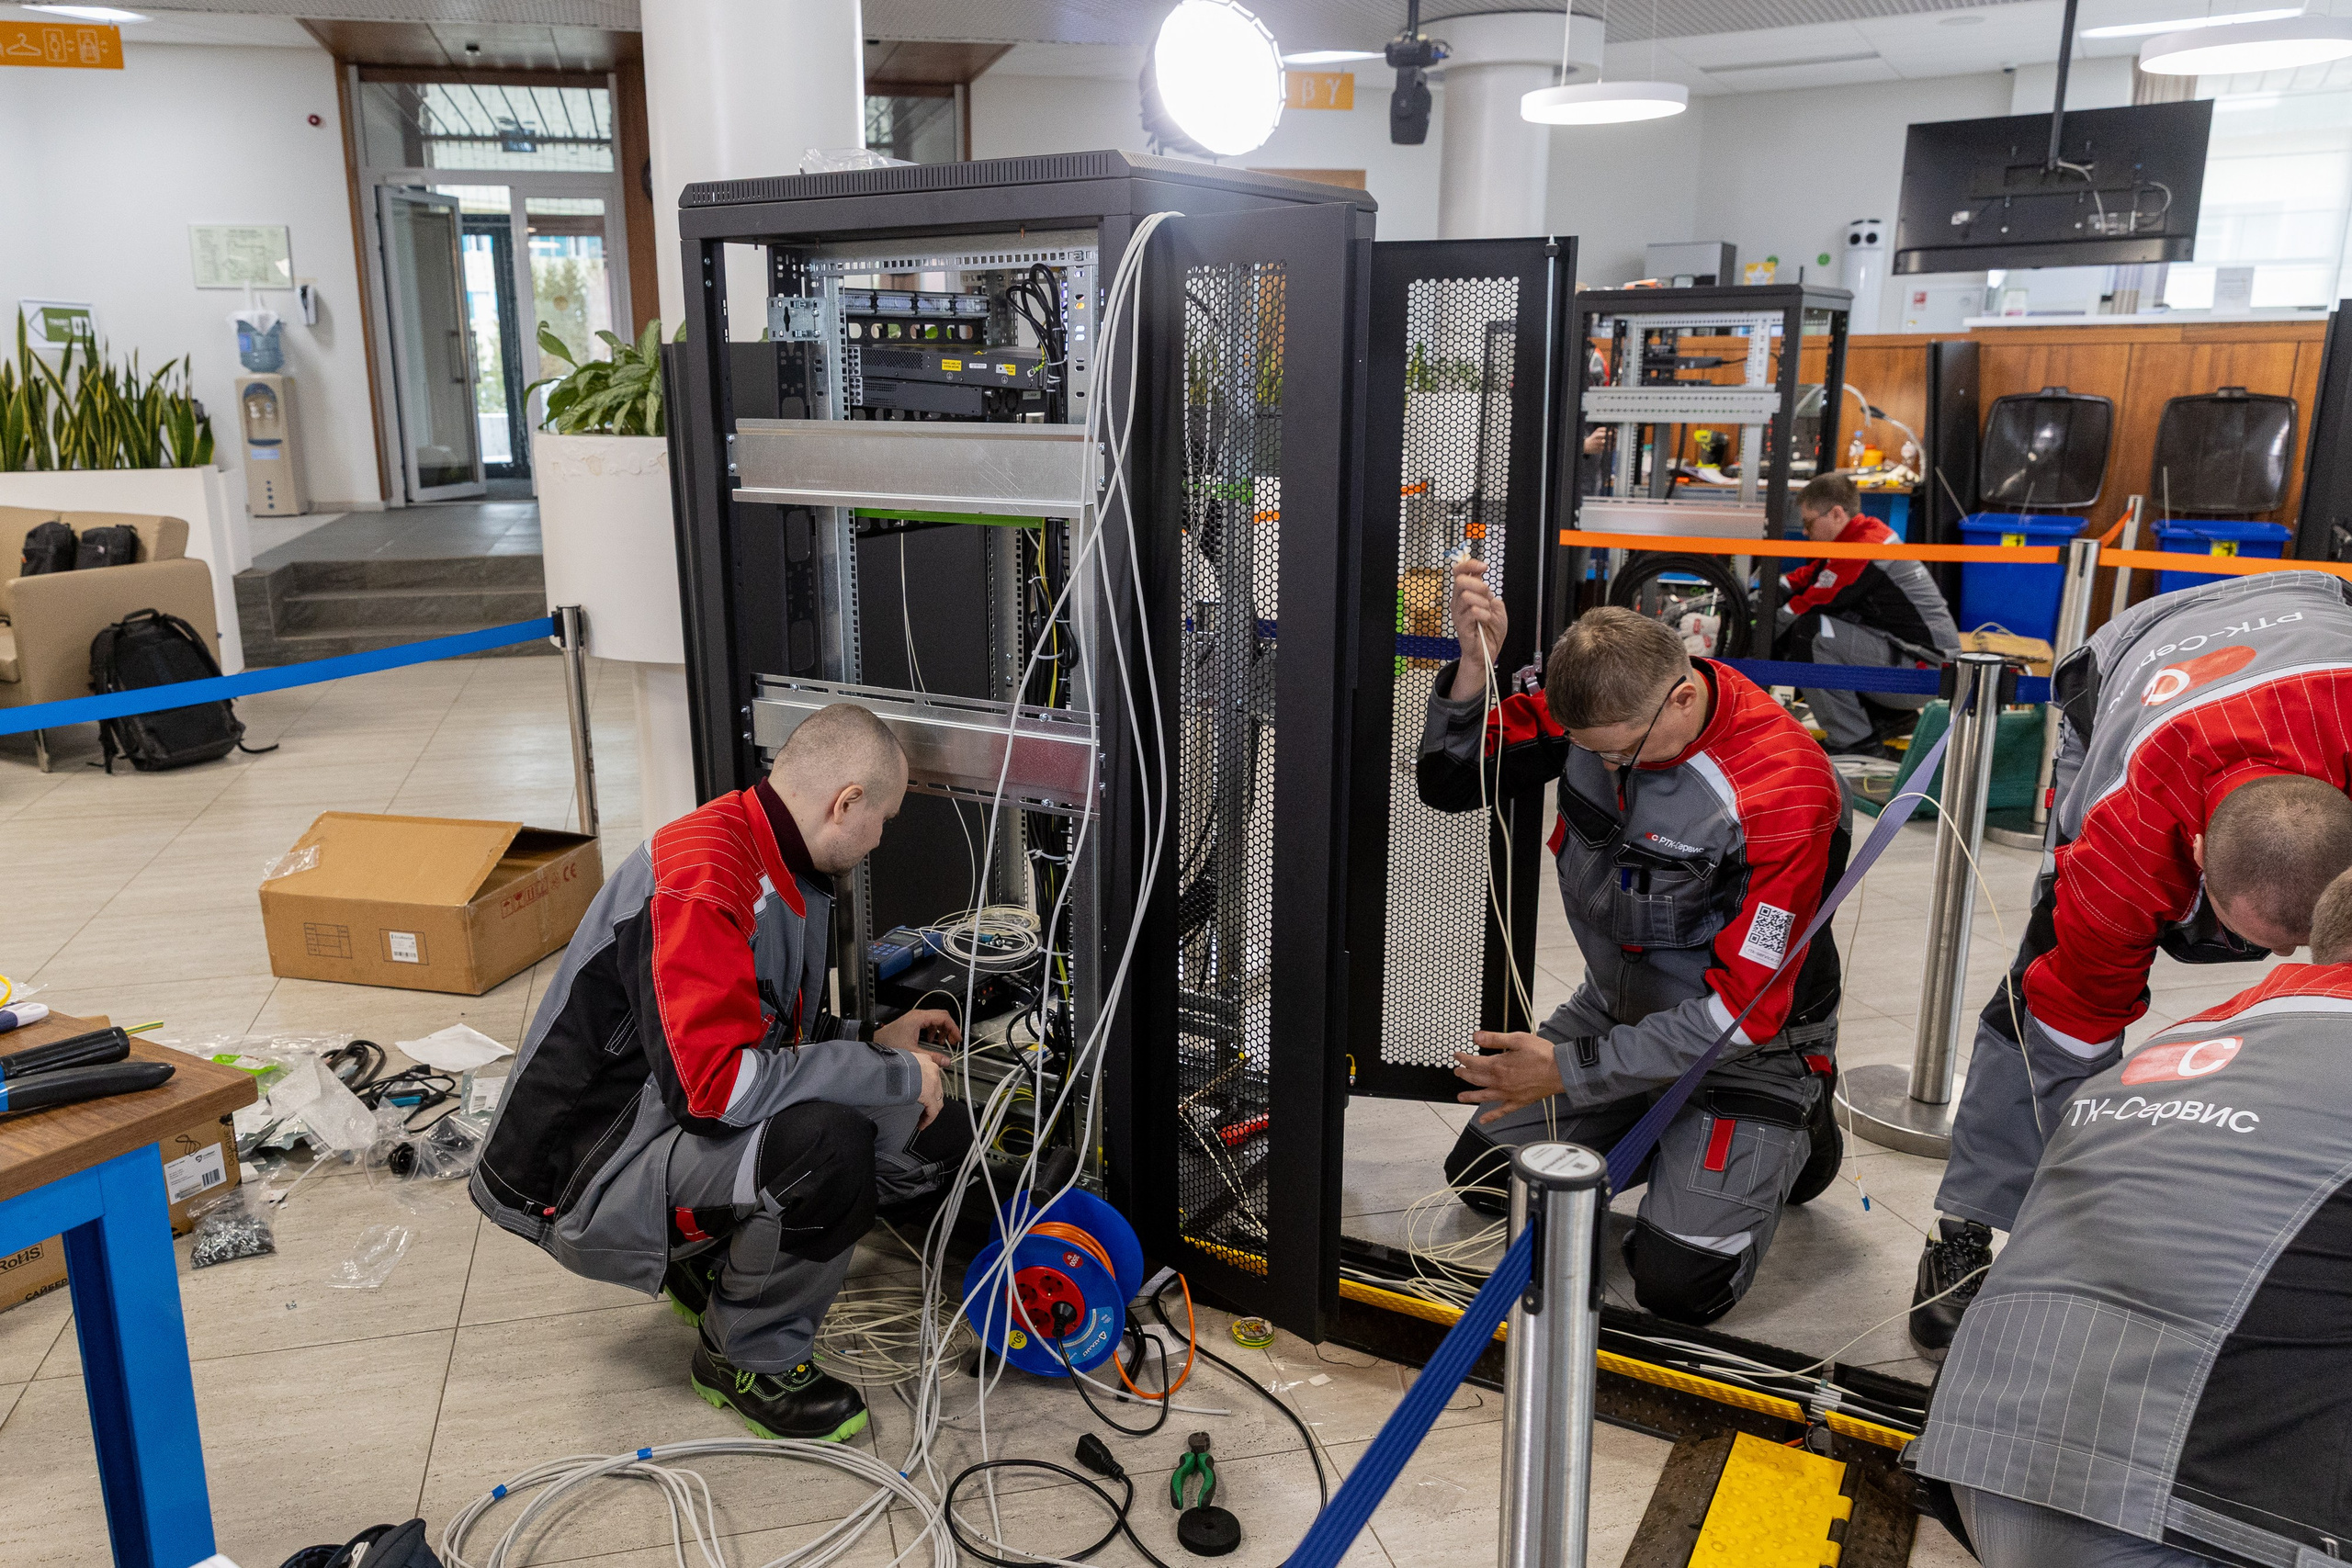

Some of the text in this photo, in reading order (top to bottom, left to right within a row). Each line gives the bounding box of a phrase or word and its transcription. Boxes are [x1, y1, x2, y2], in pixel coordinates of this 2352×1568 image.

[2064, 1096, 2260, 1134] ТК-Сервис
[0, 1247, 41, 1270] RoHS
[1069, 1253, 1080, 1267] 3500
[1015, 1332, 1024, 1344] 30
